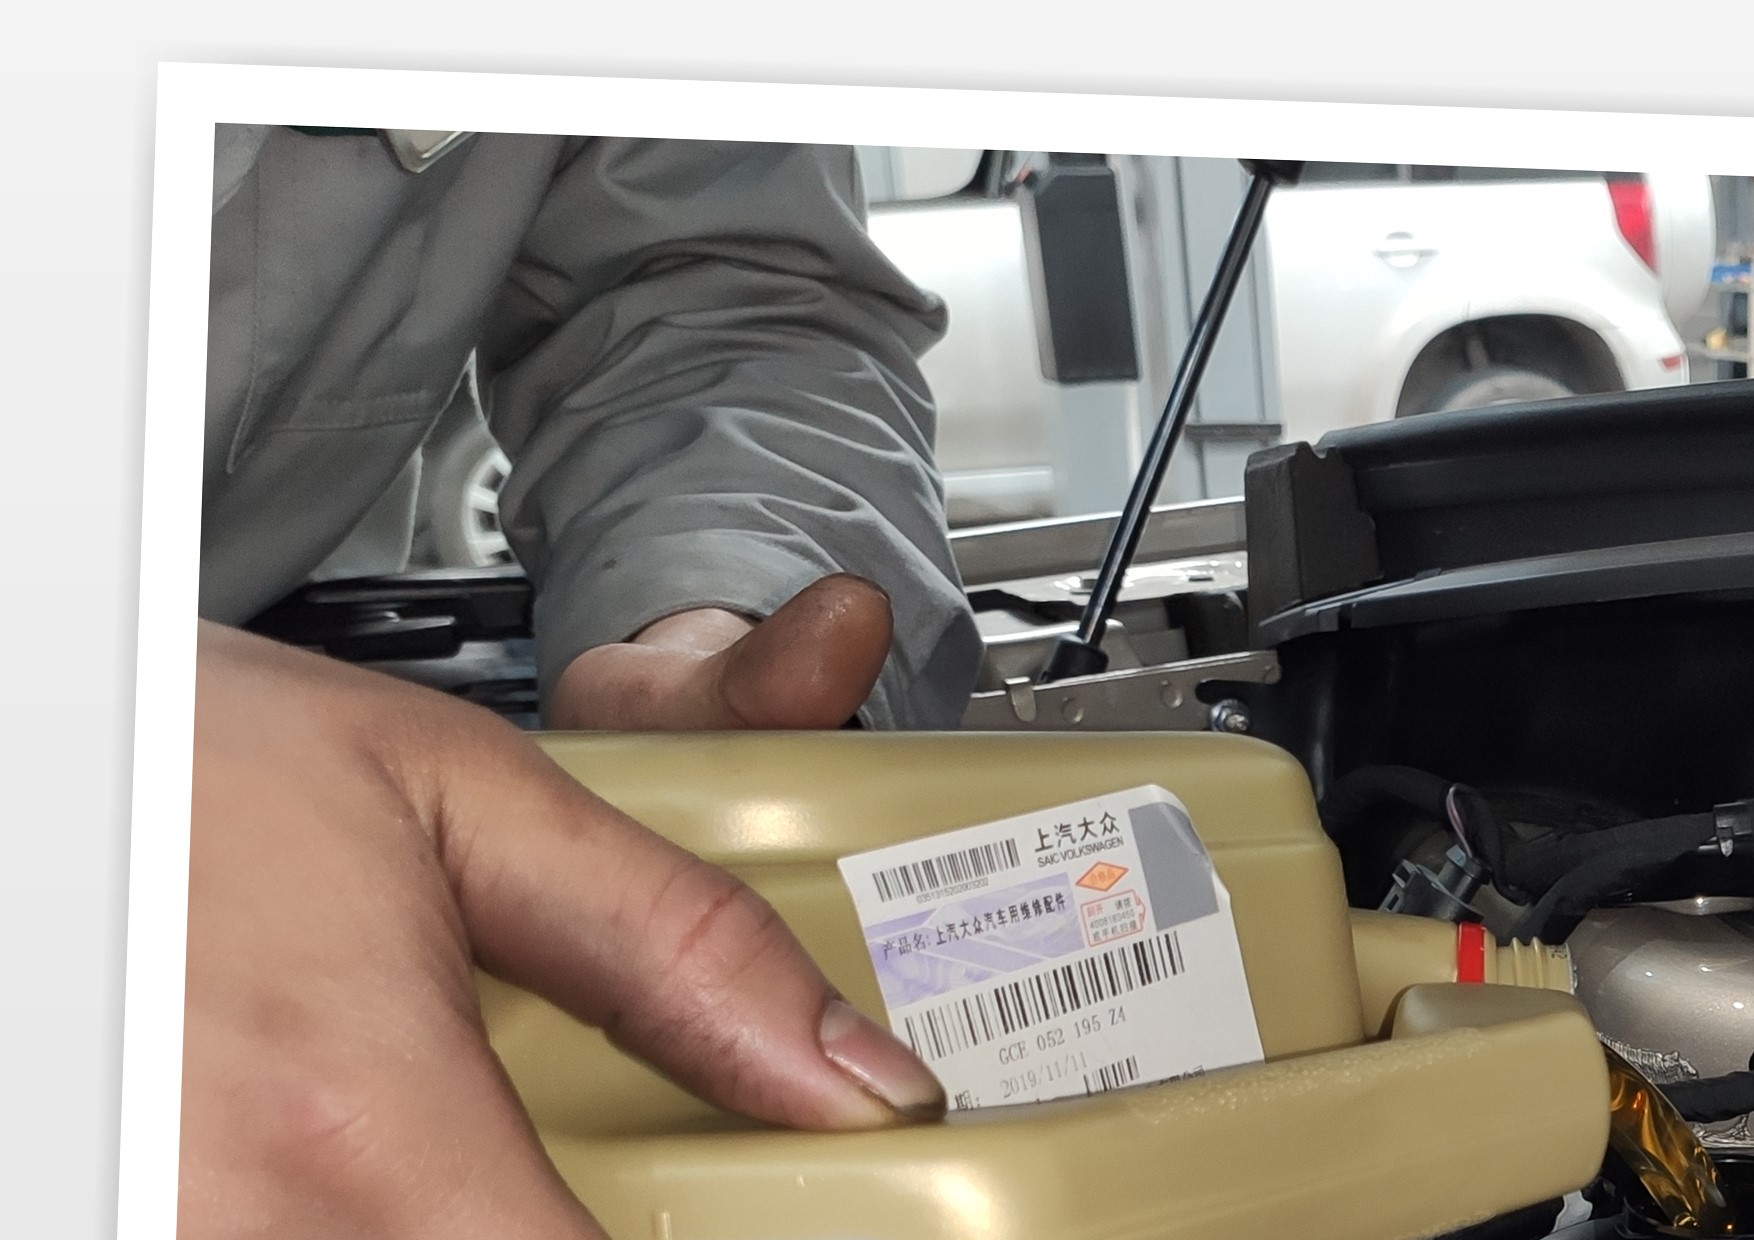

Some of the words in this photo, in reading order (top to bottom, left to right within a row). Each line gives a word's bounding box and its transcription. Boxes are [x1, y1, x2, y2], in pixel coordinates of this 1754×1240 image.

[1034, 811, 1120, 853] 上汽大众
[1037, 851, 1060, 868] SAIC
[1060, 836, 1124, 861] VOLKSWAGEN
[999, 1040, 1029, 1065] GCE
[1036, 1028, 1065, 1051] 052
[1074, 1014, 1101, 1039] 195
[1108, 1005, 1126, 1027] Z4
[1001, 1051, 1088, 1099] 2019/11/11
